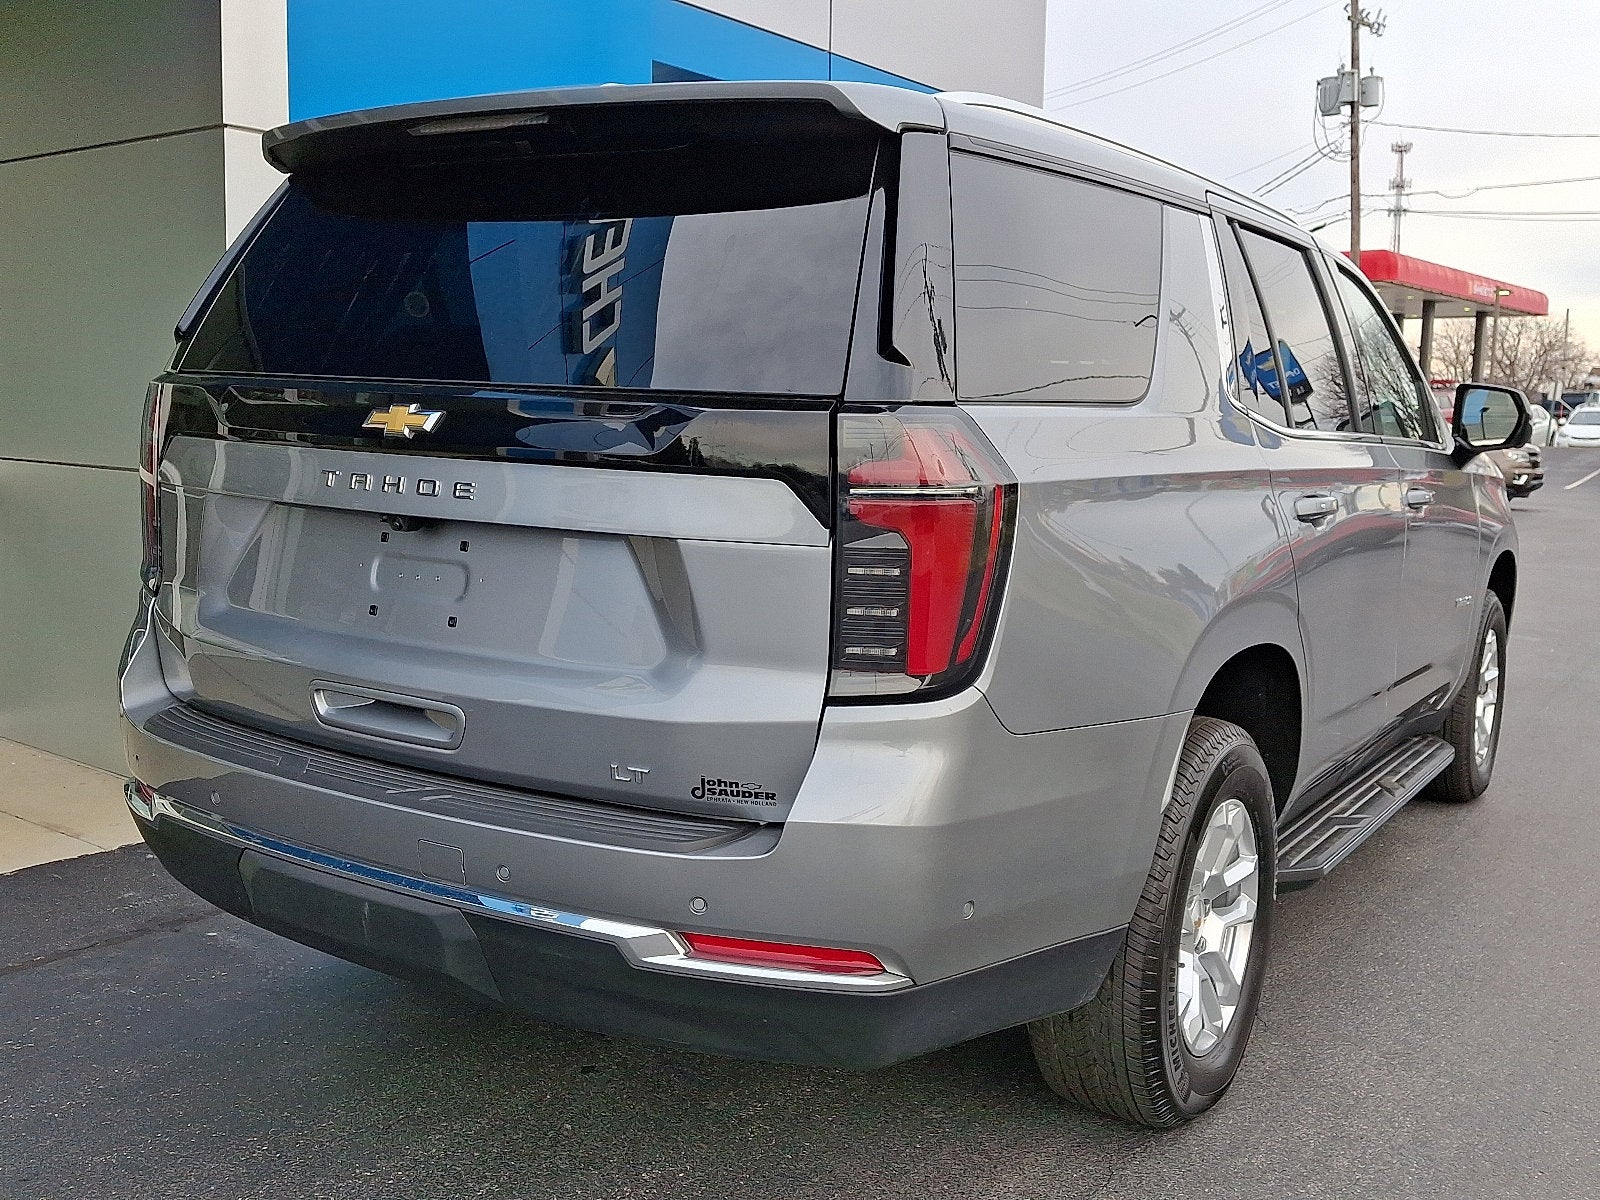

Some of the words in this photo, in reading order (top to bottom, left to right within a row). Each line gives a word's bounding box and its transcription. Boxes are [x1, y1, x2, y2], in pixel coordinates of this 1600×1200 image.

[321, 469, 477, 500] TAHOE
[610, 763, 650, 784] LT
[706, 787, 777, 801] SAUDER
[1167, 966, 1182, 1073] MICHELIN
